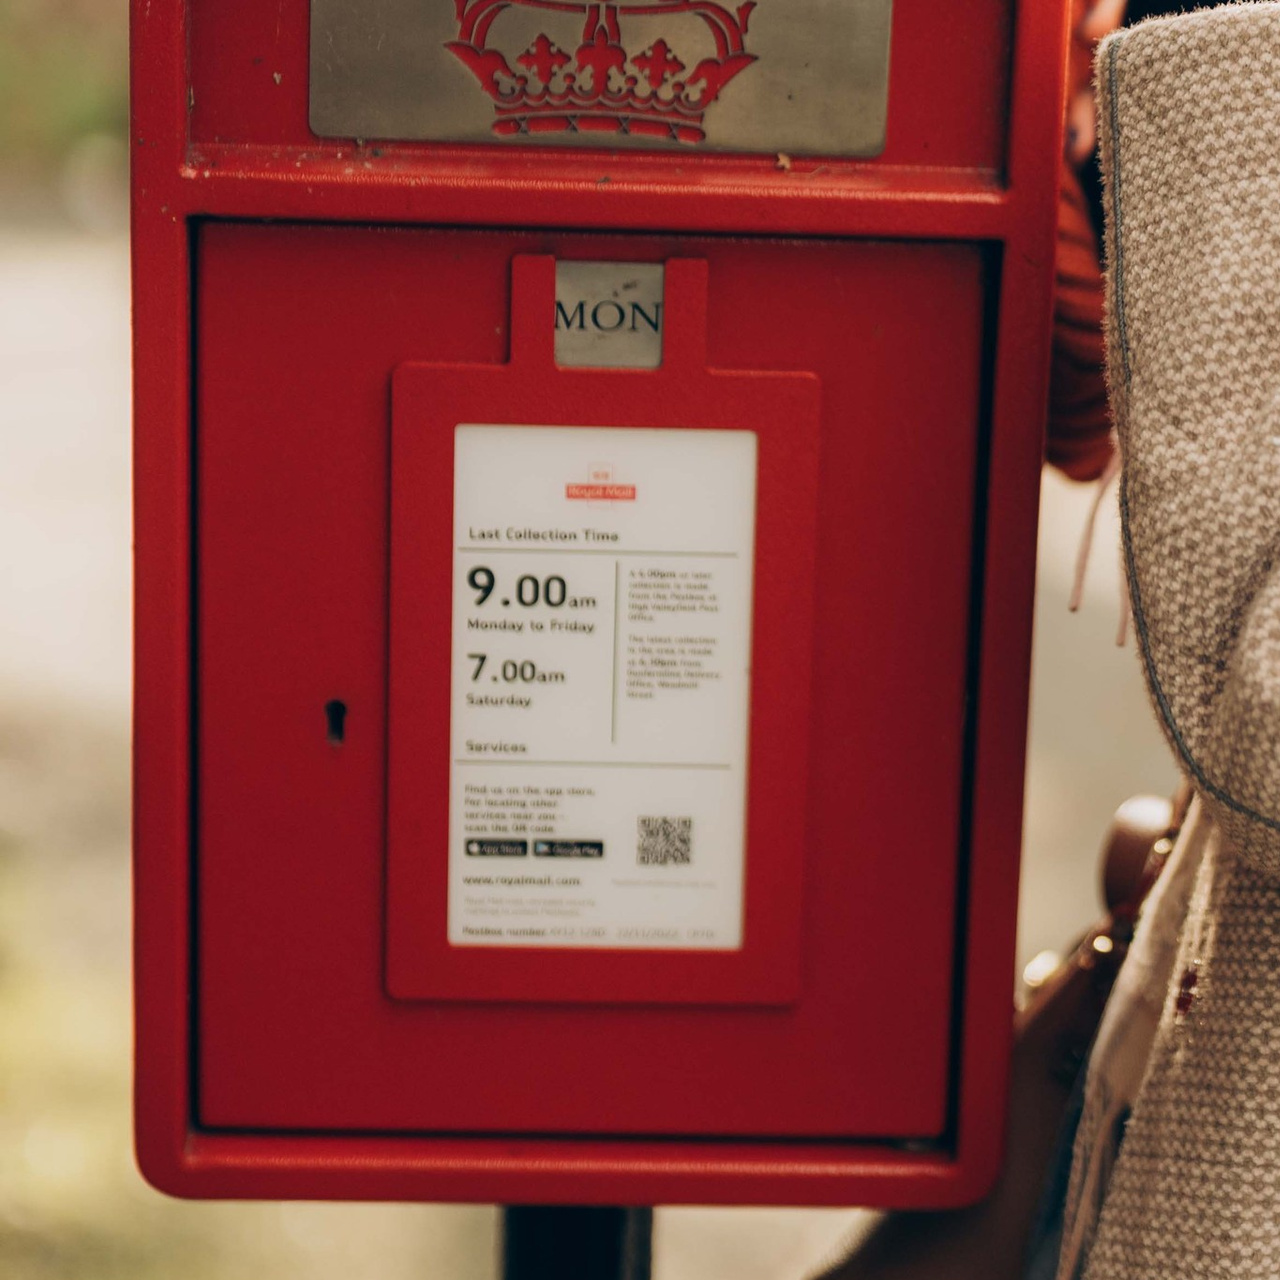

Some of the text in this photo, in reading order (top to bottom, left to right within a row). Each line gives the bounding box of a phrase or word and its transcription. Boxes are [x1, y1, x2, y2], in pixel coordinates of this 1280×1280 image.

[555, 299, 663, 334] MON
[568, 485, 632, 497] Royal Mail
[469, 526, 619, 542] Last Collection Time
[467, 566, 597, 608] 9.00am
[467, 619, 595, 634] Monday to Friday
[466, 693, 532, 707] Saturday
[466, 740, 526, 754] Services
[463, 874, 581, 887] www.royalmail.com
